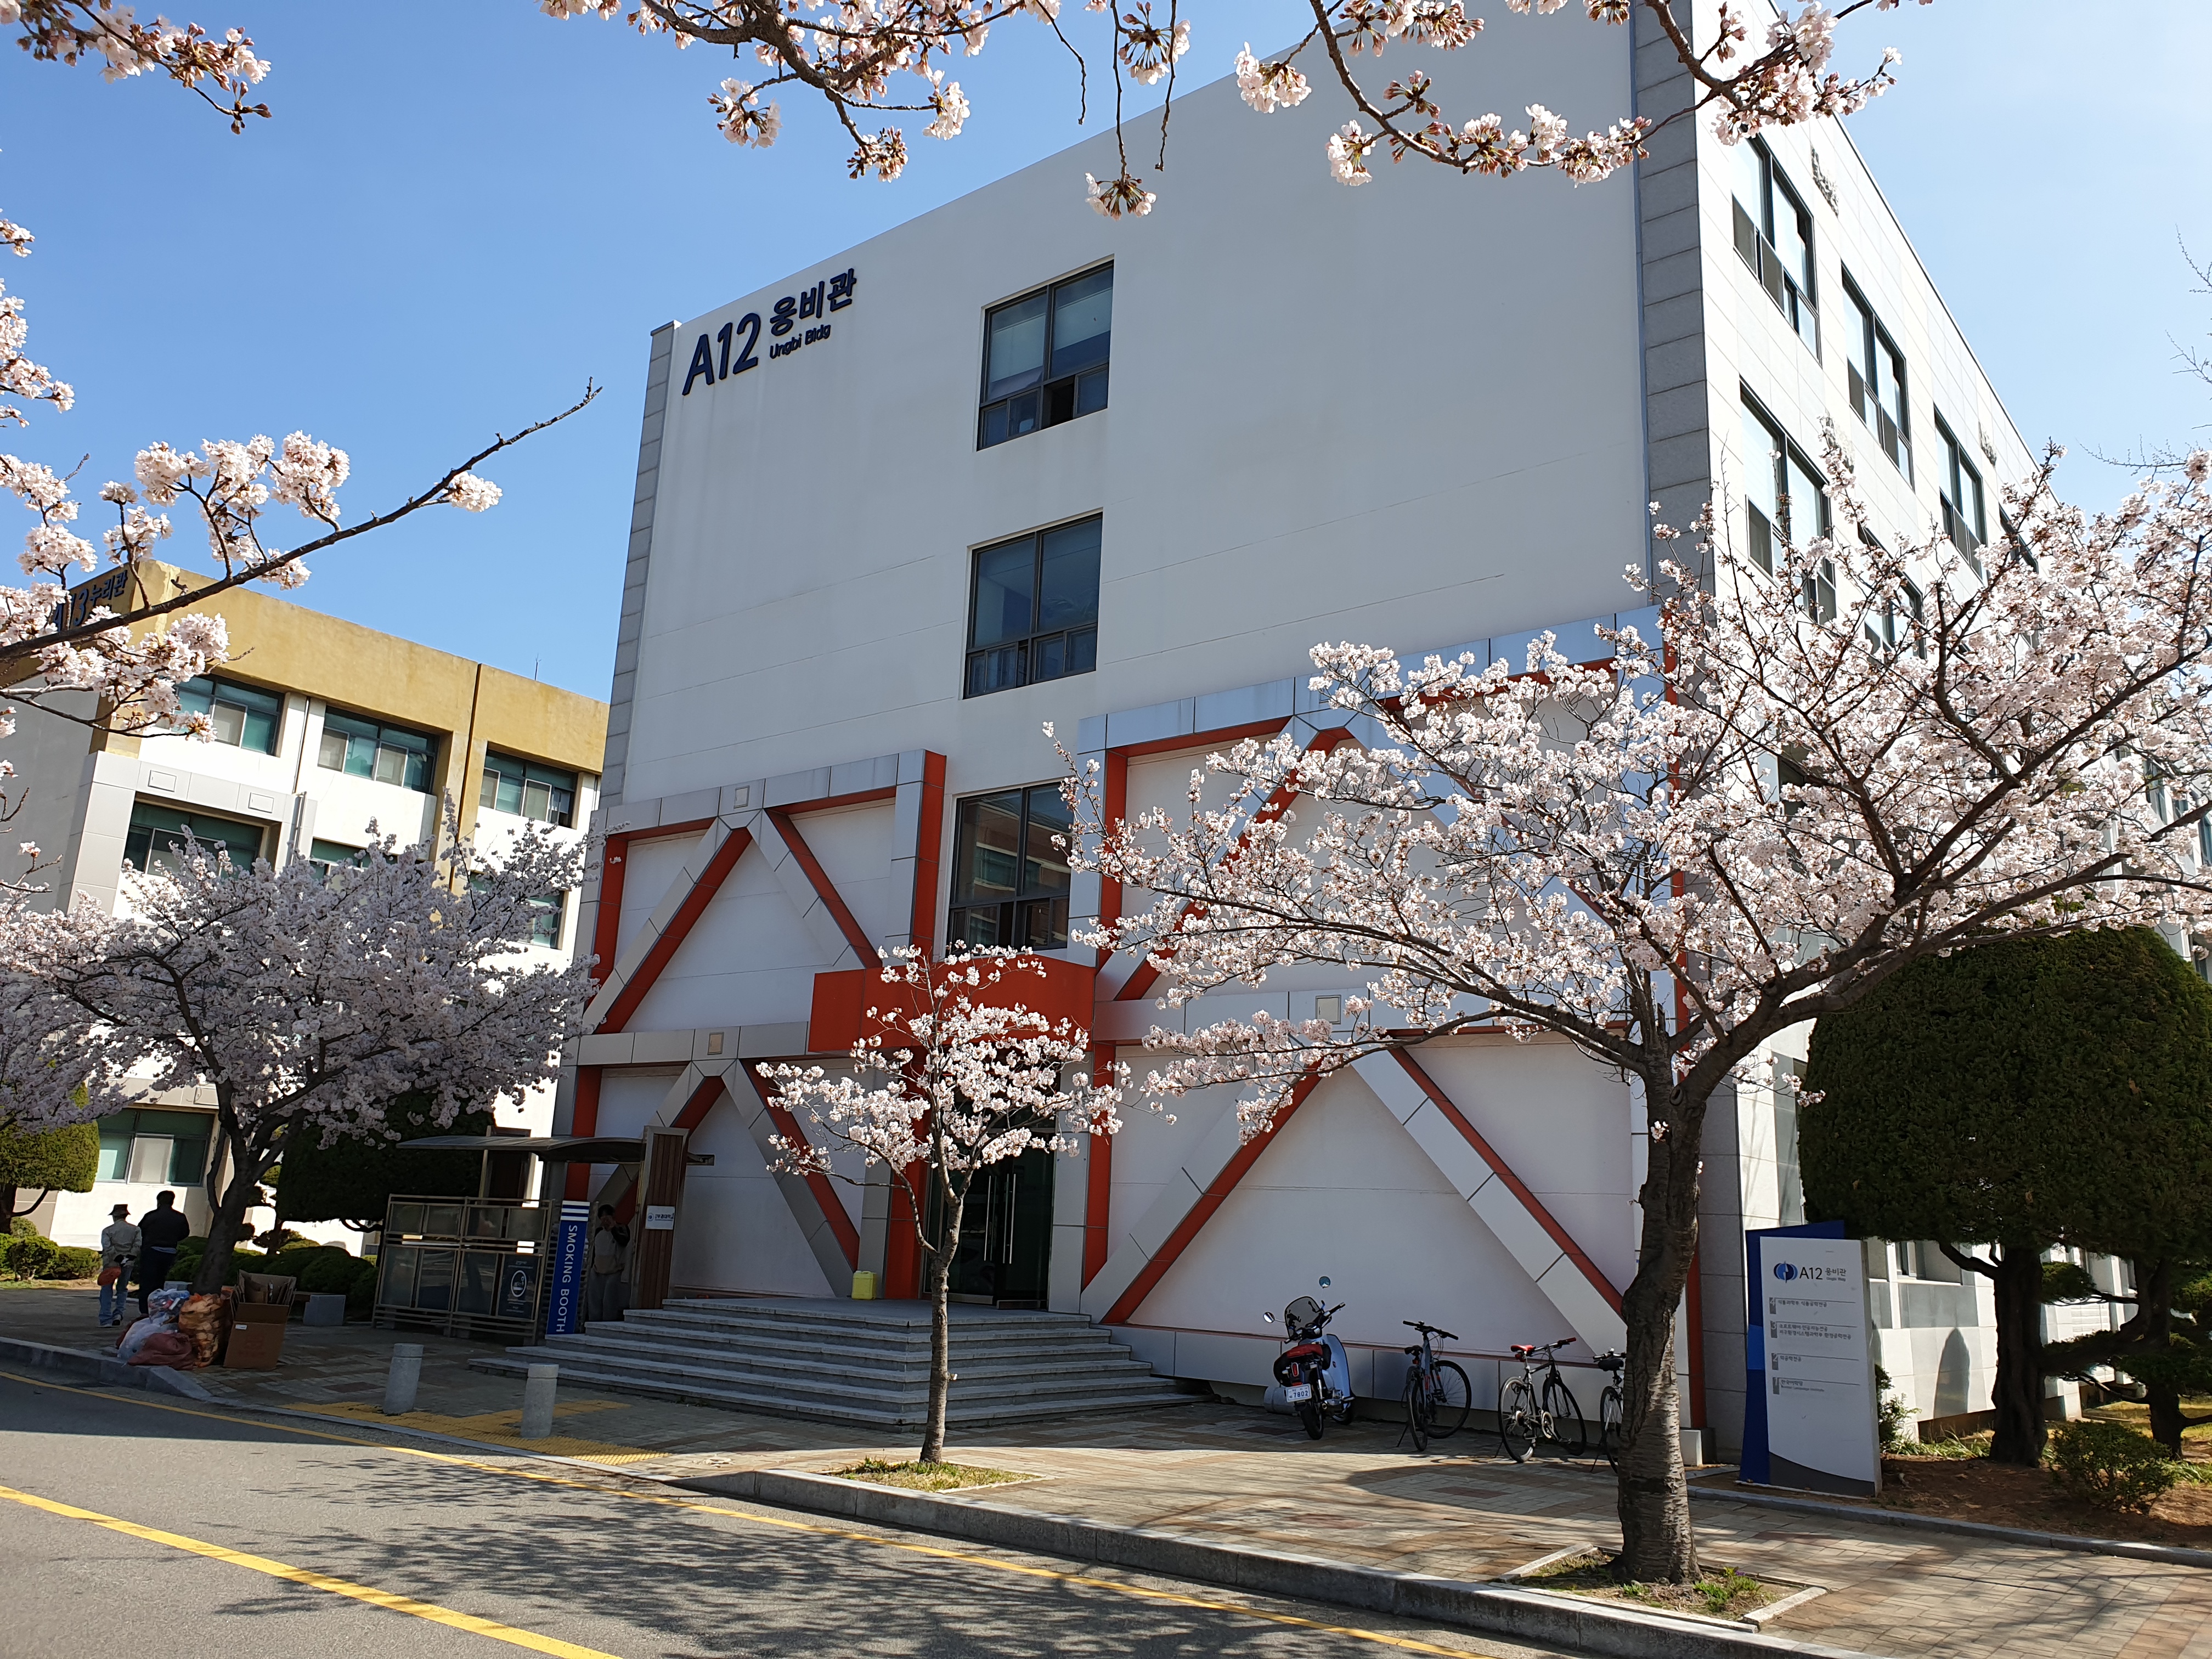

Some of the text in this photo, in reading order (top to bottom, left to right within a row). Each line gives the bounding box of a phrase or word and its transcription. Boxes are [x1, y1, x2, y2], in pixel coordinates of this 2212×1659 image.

[682, 268, 857, 396] A12 웅비관
[770, 324, 831, 359] Ungbi Bldg
[90, 569, 128, 606] 누리관
[556, 1224, 578, 1332] SMOKING BOOTH
[1799, 1266, 1847, 1280] A12 웅비관
[1771, 1321, 1777, 1330] 3
[1773, 1353, 1778, 1362] 2
